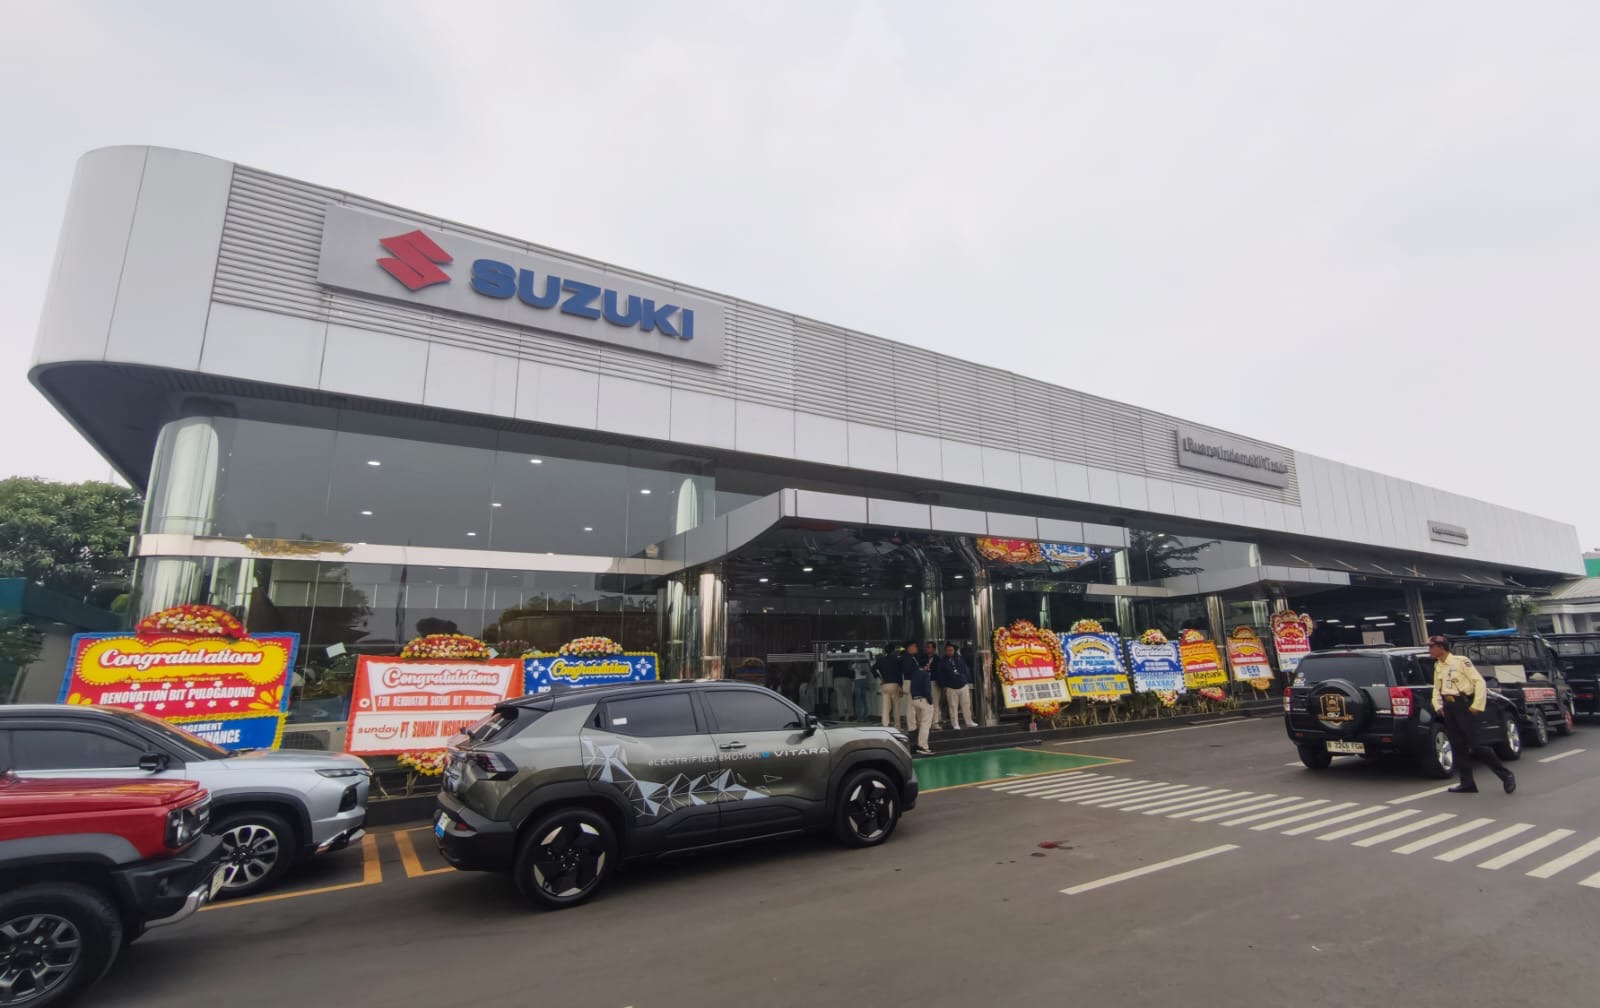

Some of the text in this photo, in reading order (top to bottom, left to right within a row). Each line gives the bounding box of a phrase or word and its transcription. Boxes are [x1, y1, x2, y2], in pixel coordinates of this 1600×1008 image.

[470, 258, 694, 341] SUZUKI
[100, 648, 262, 671] Congratulations
[383, 667, 500, 689] Congratulations
[100, 689, 168, 705] RENOVATION
[188, 686, 256, 700] PULOGADUNG
[358, 725, 399, 736] sunday
[400, 721, 411, 738] PT
[412, 720, 440, 738] SUNDAY
[774, 746, 830, 757] VITARA
